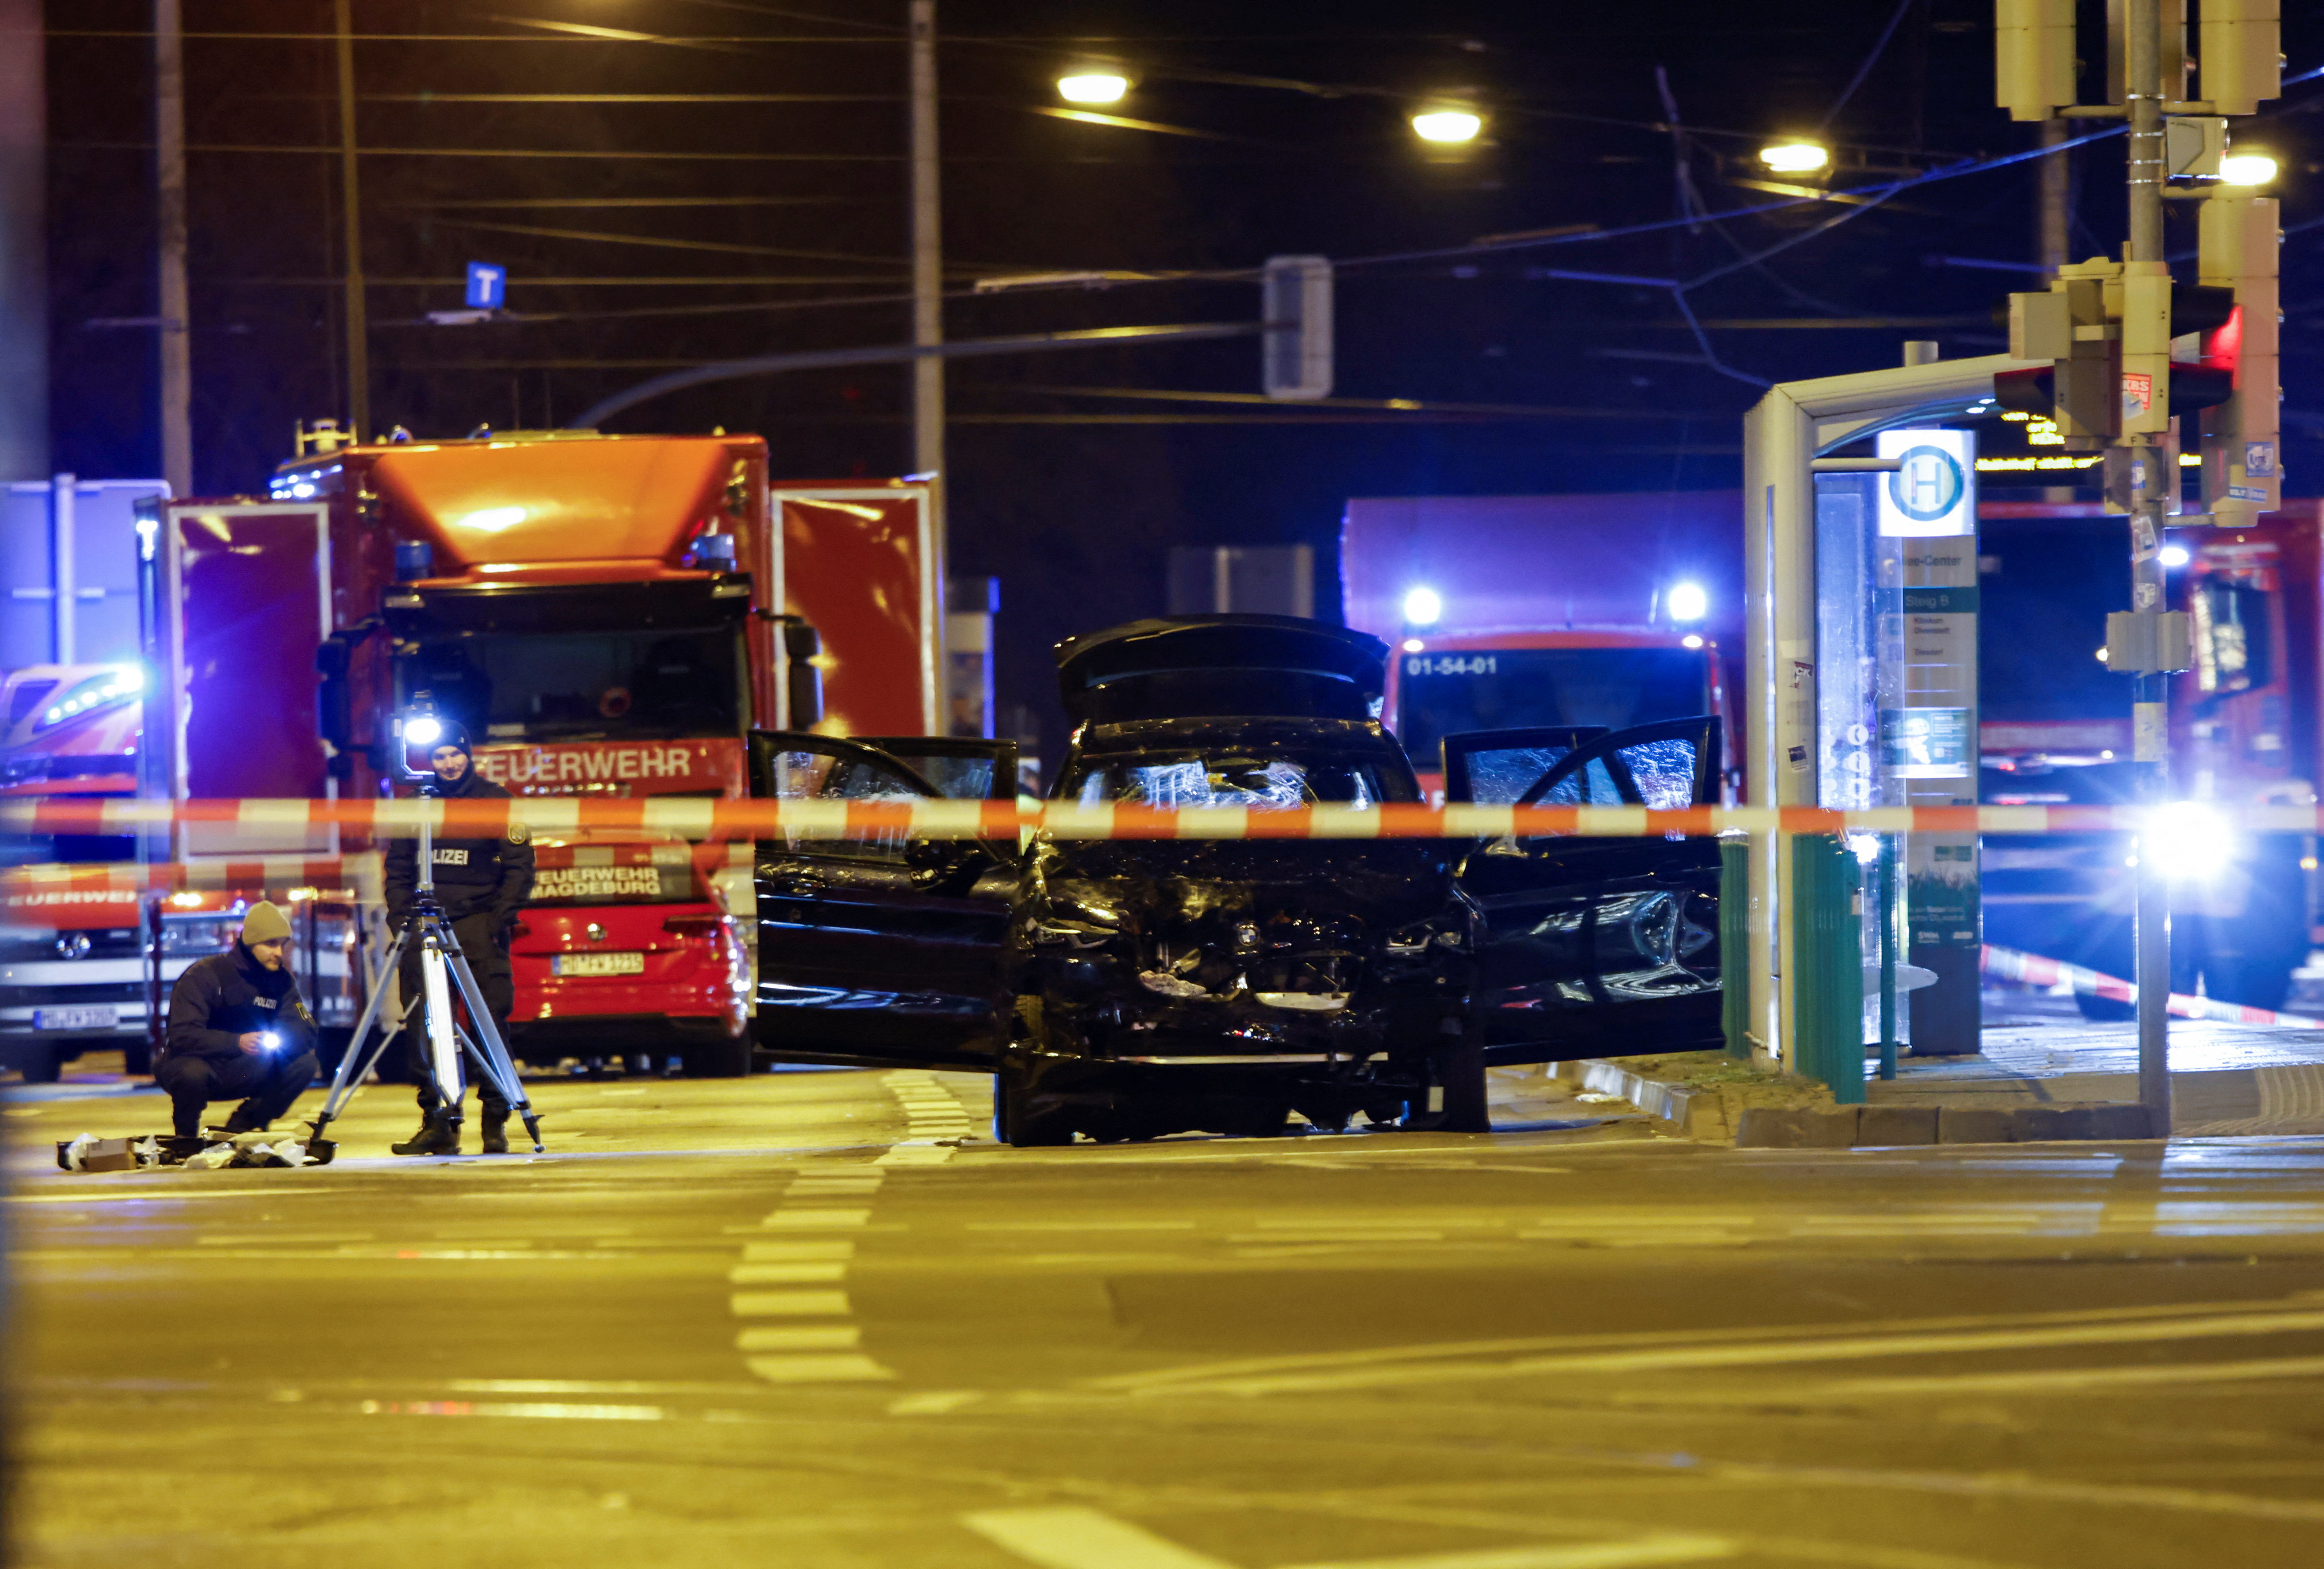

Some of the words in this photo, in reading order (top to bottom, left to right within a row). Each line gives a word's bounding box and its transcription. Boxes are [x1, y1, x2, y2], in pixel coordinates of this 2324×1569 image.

[475, 269, 499, 303] T
[1911, 463, 1942, 504] H
[1407, 656, 1496, 676] 01-54-01
[417, 849, 469, 866] LIZEI
